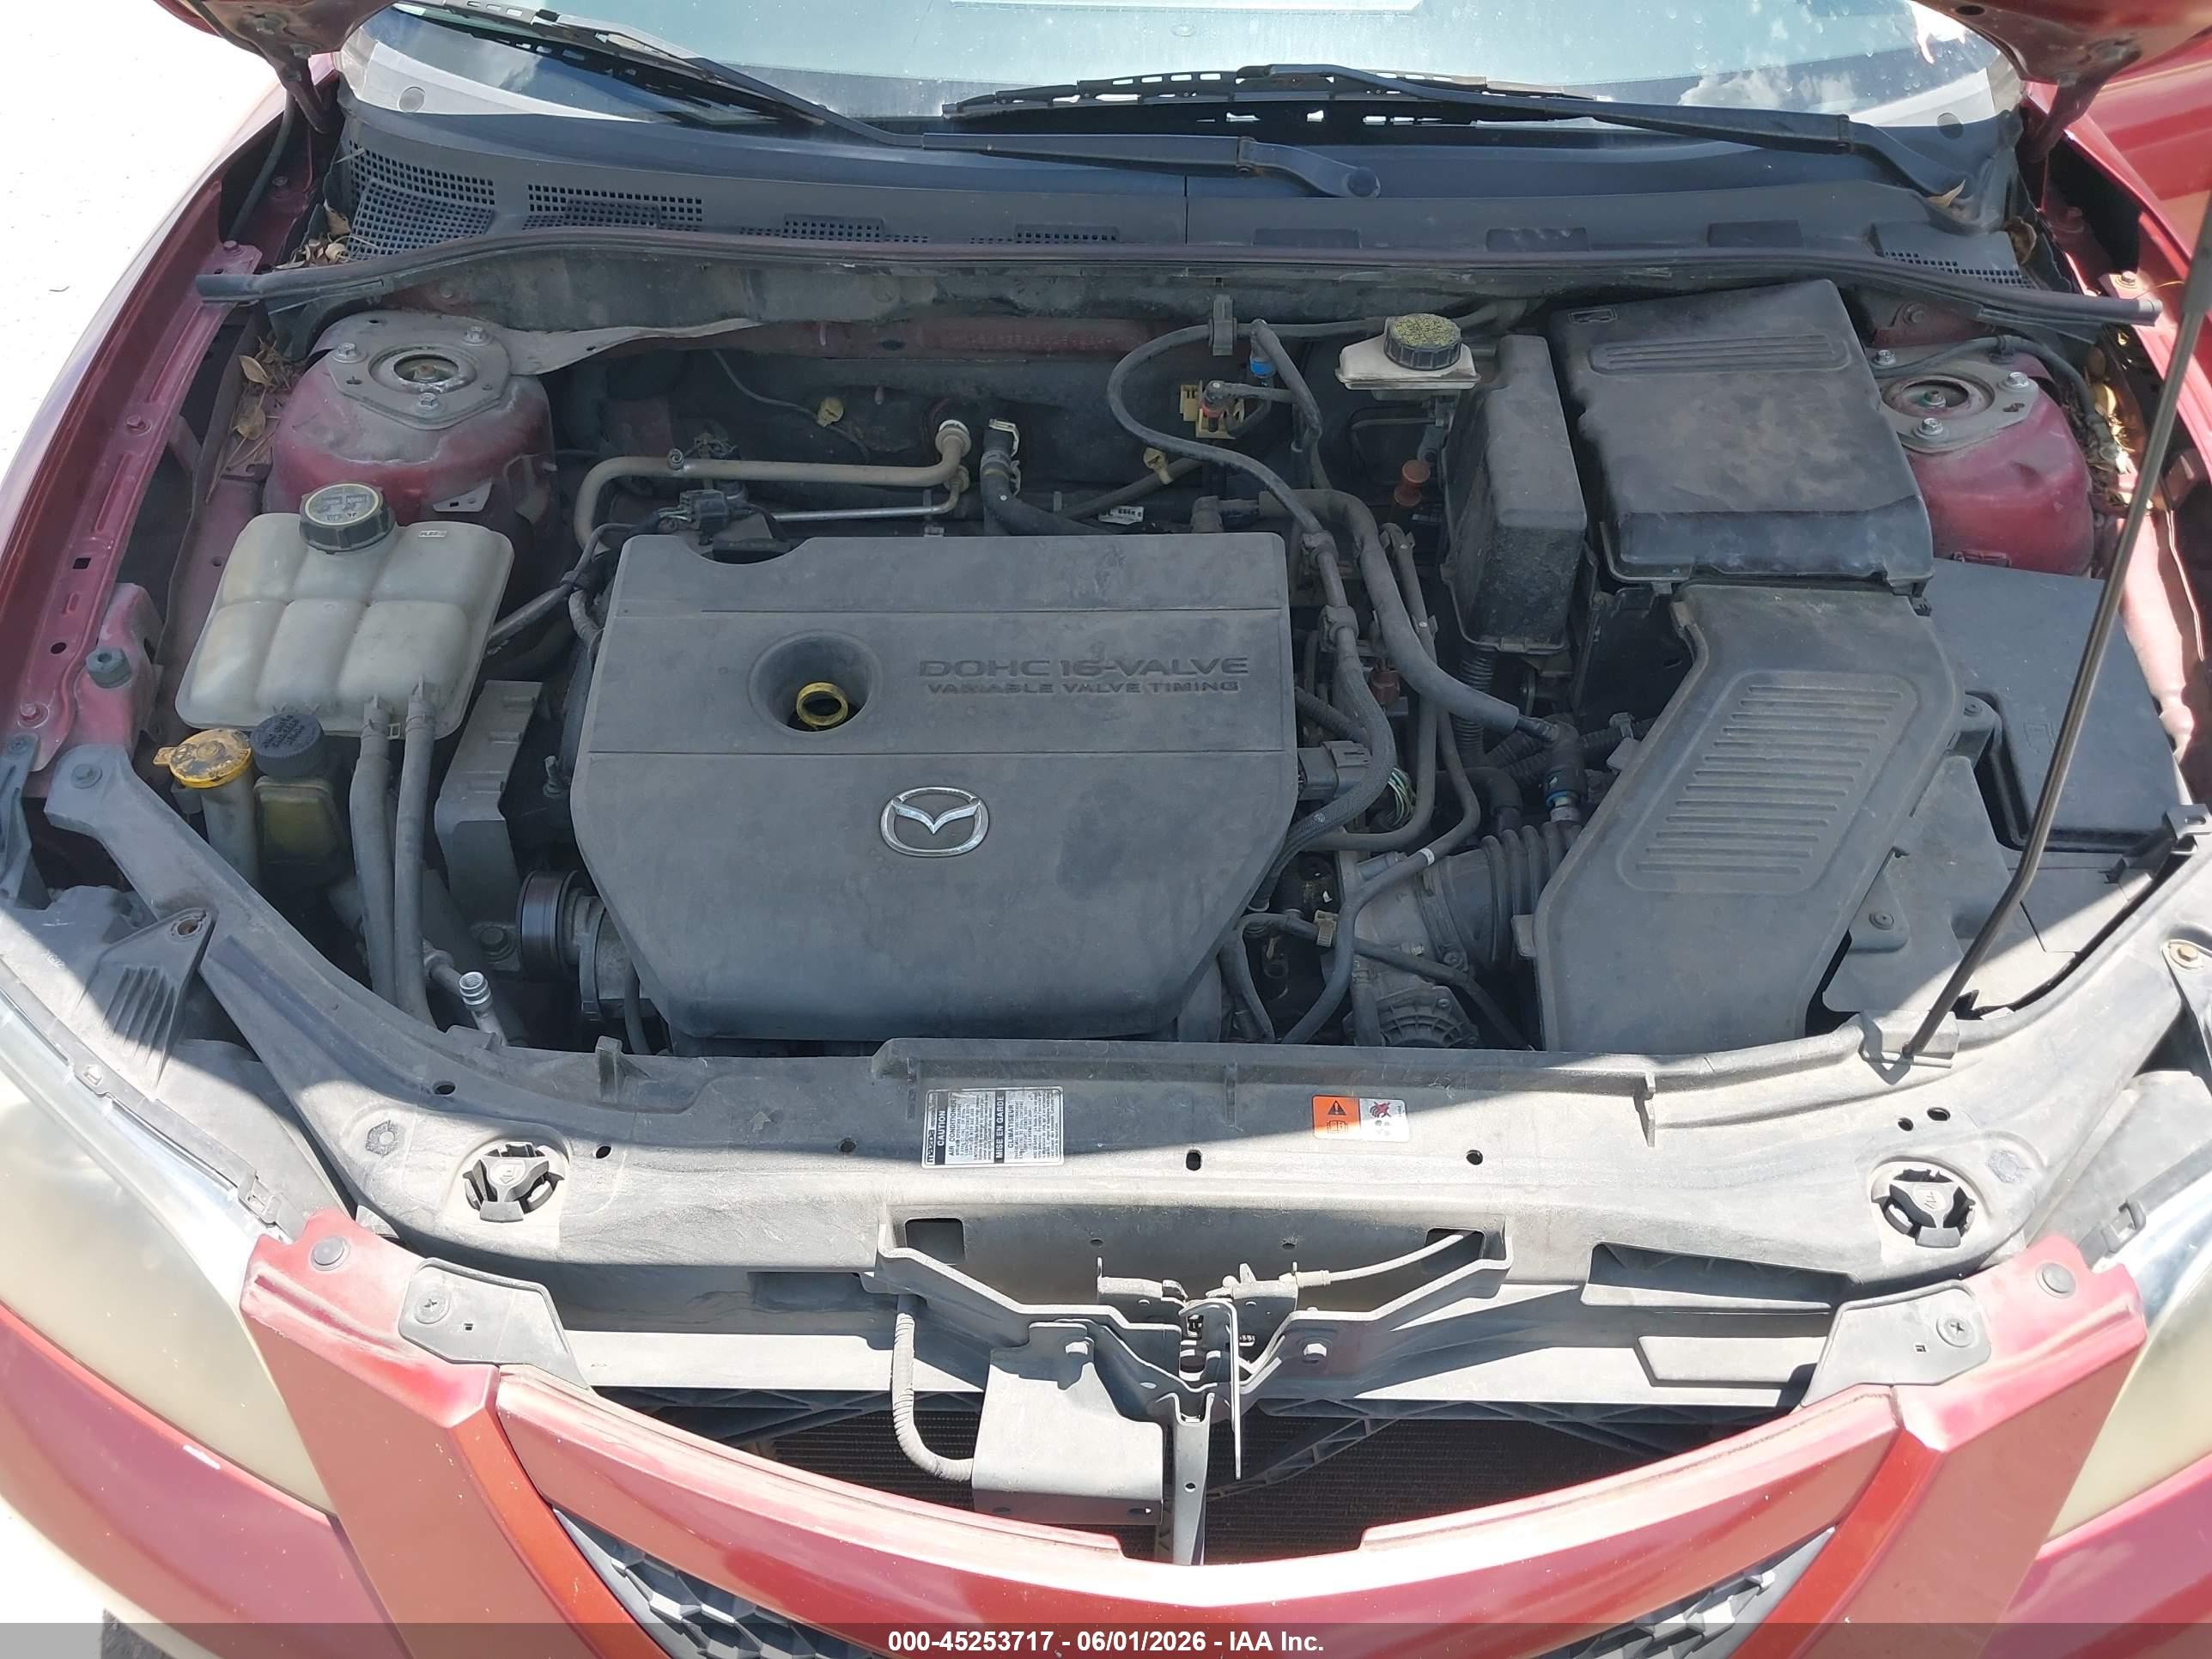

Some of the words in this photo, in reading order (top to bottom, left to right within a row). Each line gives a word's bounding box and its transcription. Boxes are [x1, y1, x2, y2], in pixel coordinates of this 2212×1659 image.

[920, 660, 1051, 677] DOHC
[1060, 658, 1249, 677] 16-VALVE
[1062, 683, 1141, 694] VALVE
[1147, 681, 1239, 693] TIMING
[996, 1095, 1005, 1123] GARDE
[937, 1110, 946, 1146] CAUTION
[996, 1126, 1004, 1139] EN
